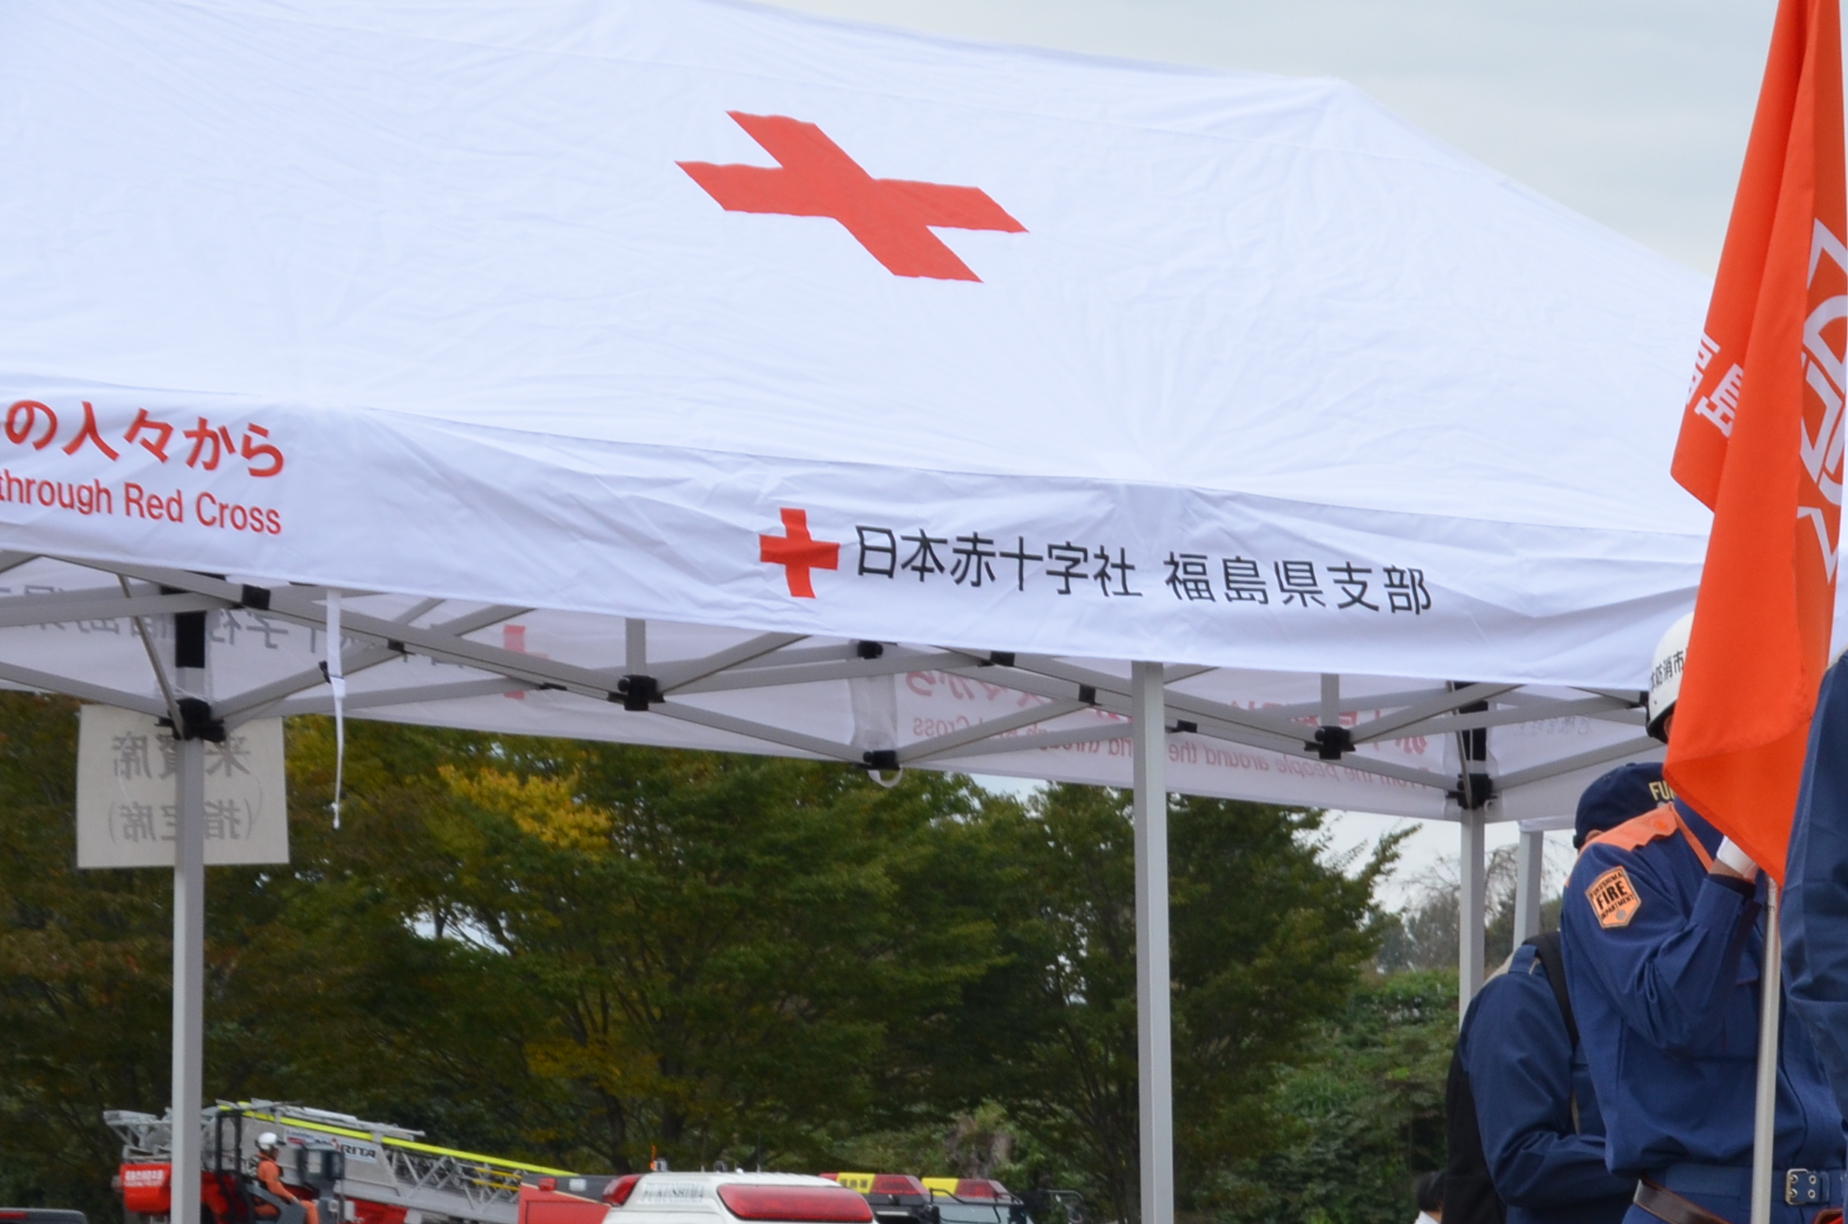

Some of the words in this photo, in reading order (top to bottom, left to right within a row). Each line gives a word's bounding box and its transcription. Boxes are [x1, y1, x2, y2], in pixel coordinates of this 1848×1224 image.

[123, 481, 184, 523] Red
[195, 491, 282, 535] Cross
[855, 524, 1143, 598] 日本赤十字社
[1163, 551, 1432, 615] 福島県支部
[1596, 879, 1628, 911] FIRE
